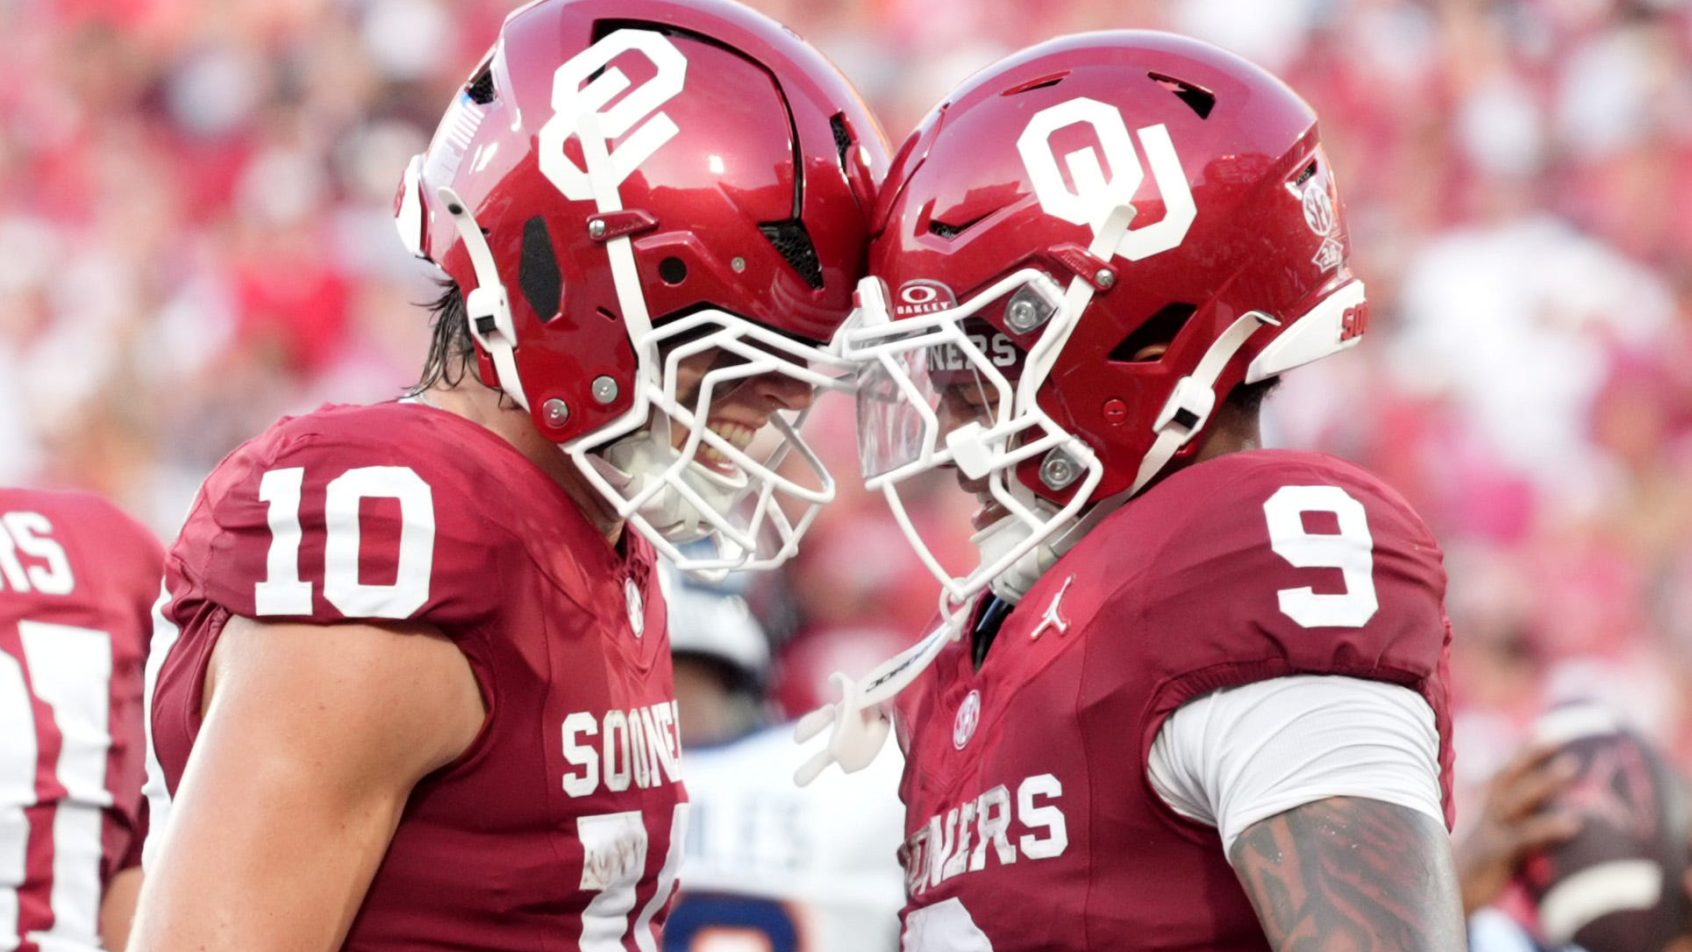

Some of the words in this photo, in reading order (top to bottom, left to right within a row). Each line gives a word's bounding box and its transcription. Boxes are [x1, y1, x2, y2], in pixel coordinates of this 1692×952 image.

[1016, 96, 1198, 262] OU
[896, 300, 952, 316] OAKLEY
[254, 466, 436, 620] 10
[1263, 485, 1380, 629] 9
[562, 700, 682, 798] SOONE
